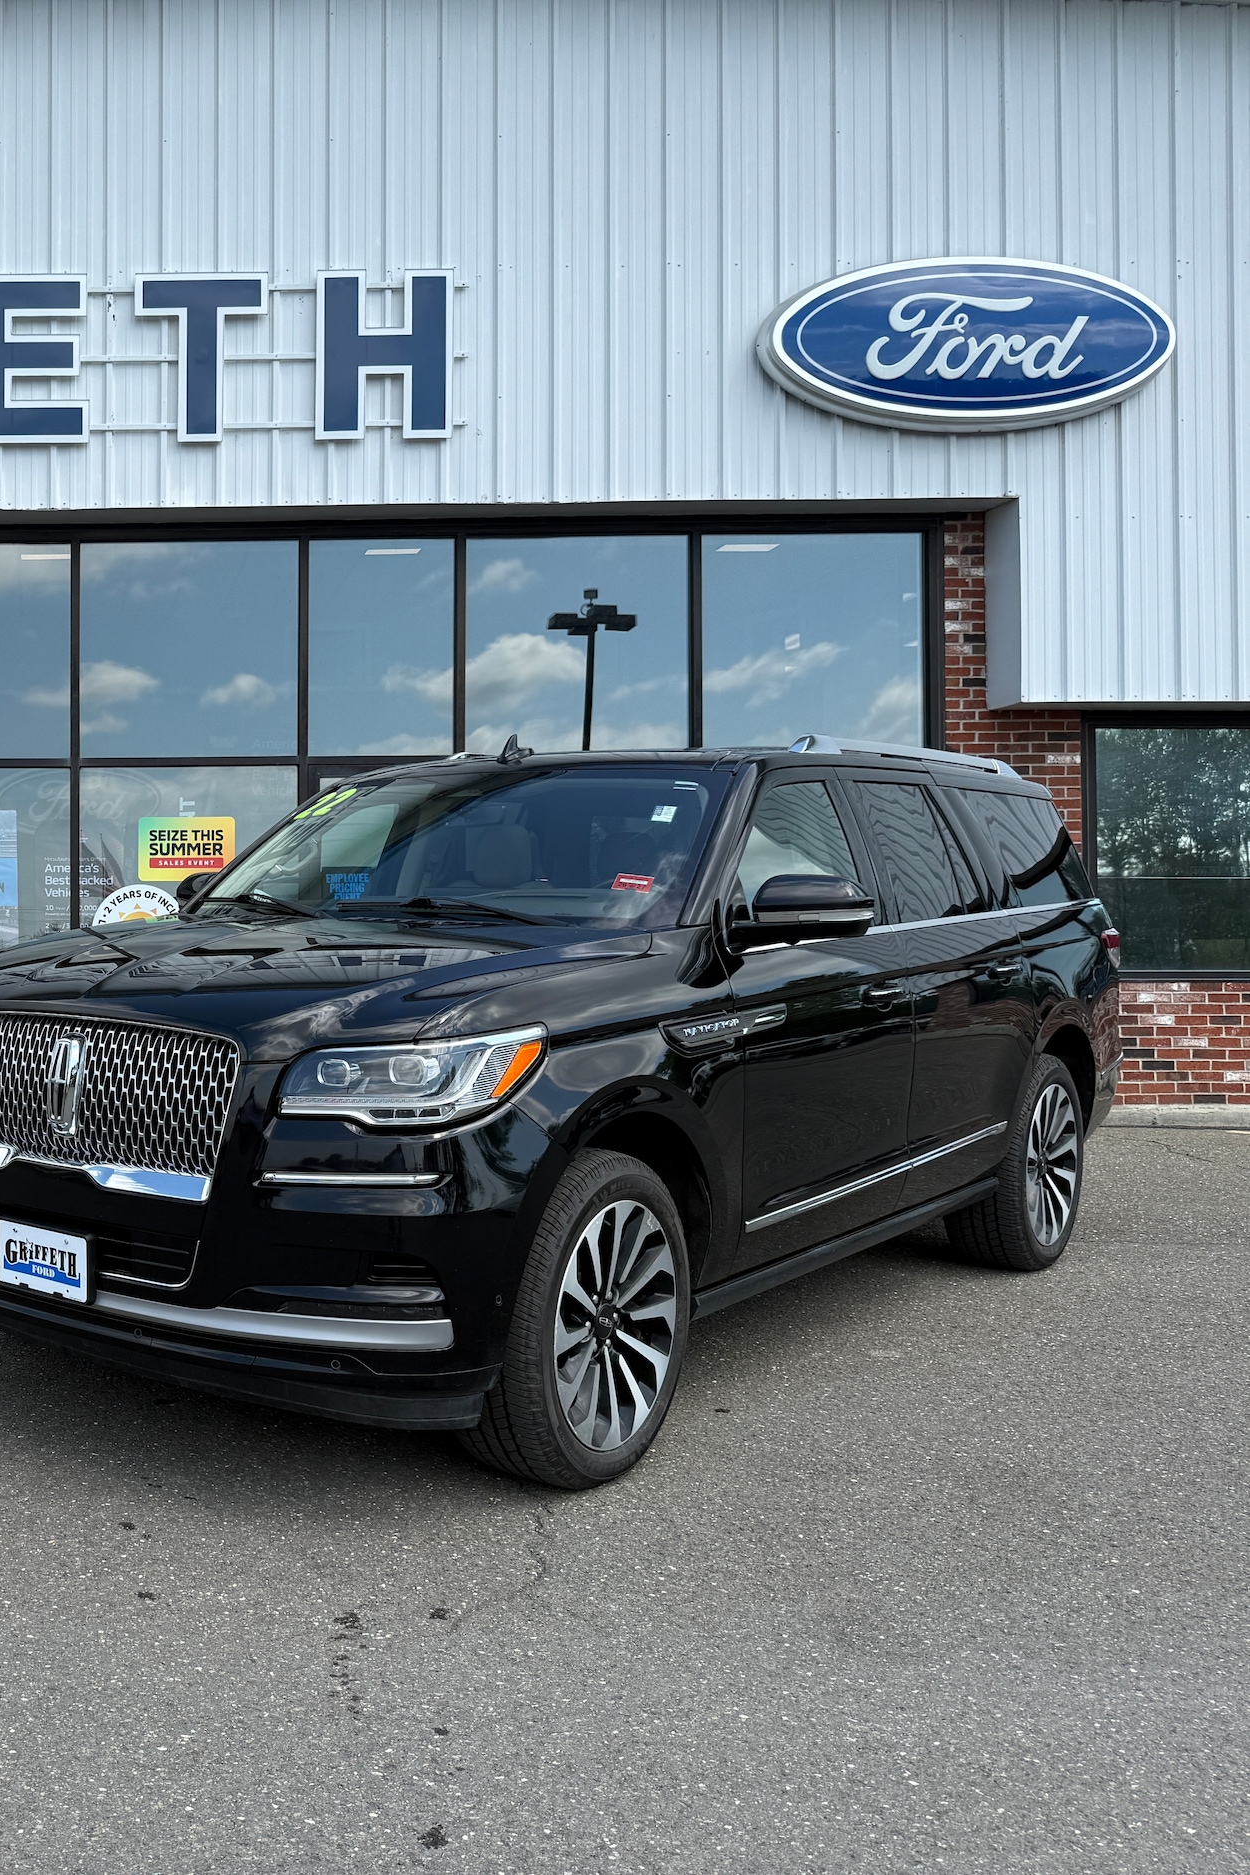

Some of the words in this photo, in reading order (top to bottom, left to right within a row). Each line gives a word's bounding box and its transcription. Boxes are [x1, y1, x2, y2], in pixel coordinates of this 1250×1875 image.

[864, 292, 1090, 382] Ford
[293, 788, 357, 820] 22
[149, 829, 188, 842] SEIZE
[191, 829, 224, 841] THIS
[149, 843, 223, 856] SUMMER
[44, 863, 100, 873] Ameca's
[45, 875, 71, 885] Best
[78, 875, 114, 886] acked
[325, 873, 369, 883] EMPLOYEE
[330, 882, 365, 893] PRICING
[110, 890, 142, 907] YEARS
[144, 890, 158, 900] OF
[4, 1238, 77, 1278] GRIFFETH
[31, 1264, 56, 1278] FORD
